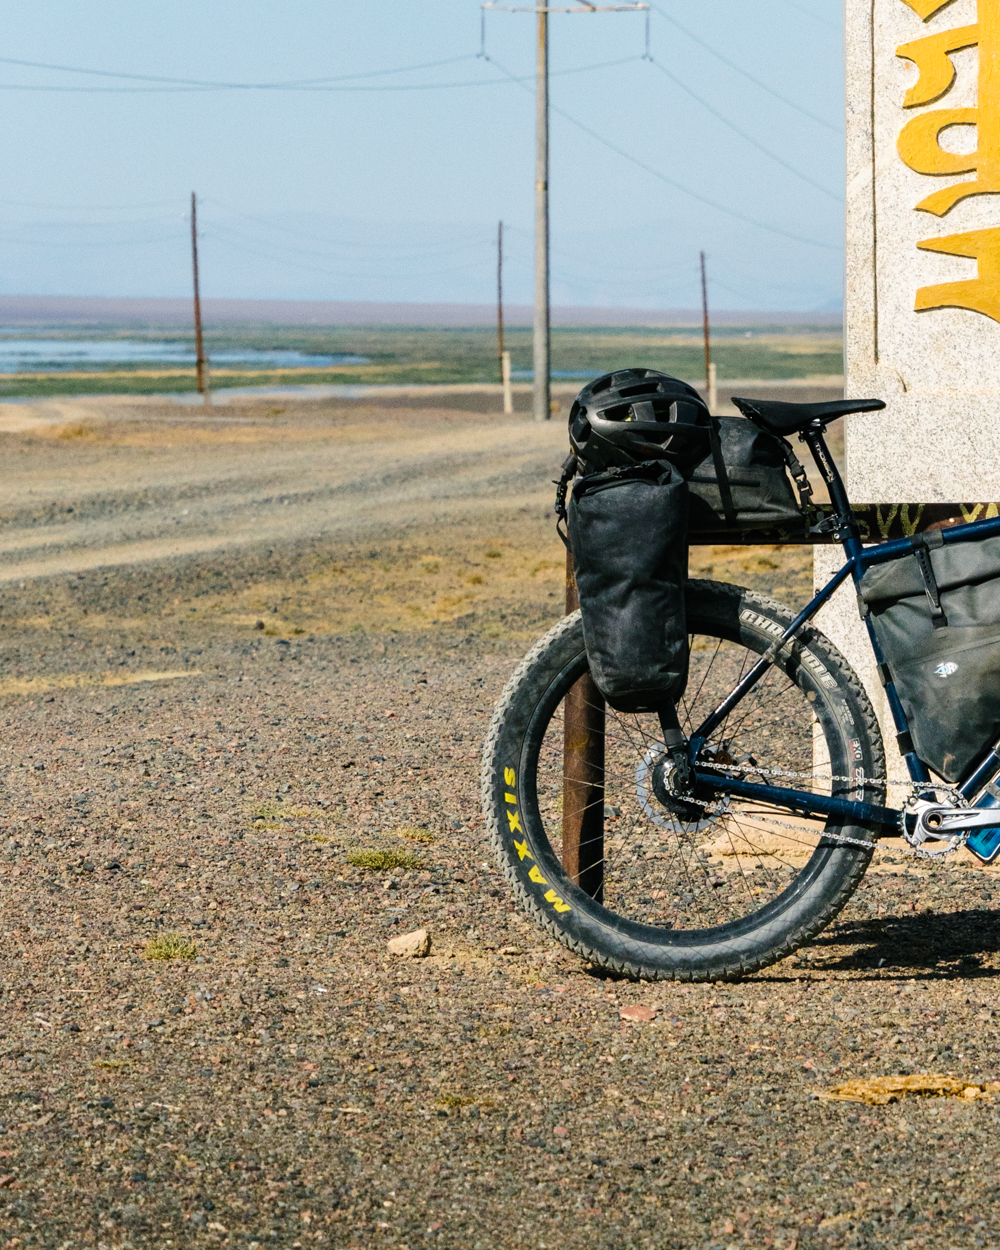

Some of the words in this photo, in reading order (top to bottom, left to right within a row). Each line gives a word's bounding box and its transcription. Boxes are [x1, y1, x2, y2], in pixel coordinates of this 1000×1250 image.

[739, 609, 838, 689] CHRNICLE
[852, 738, 863, 760] EXO
[503, 766, 572, 913] MAXXIS
